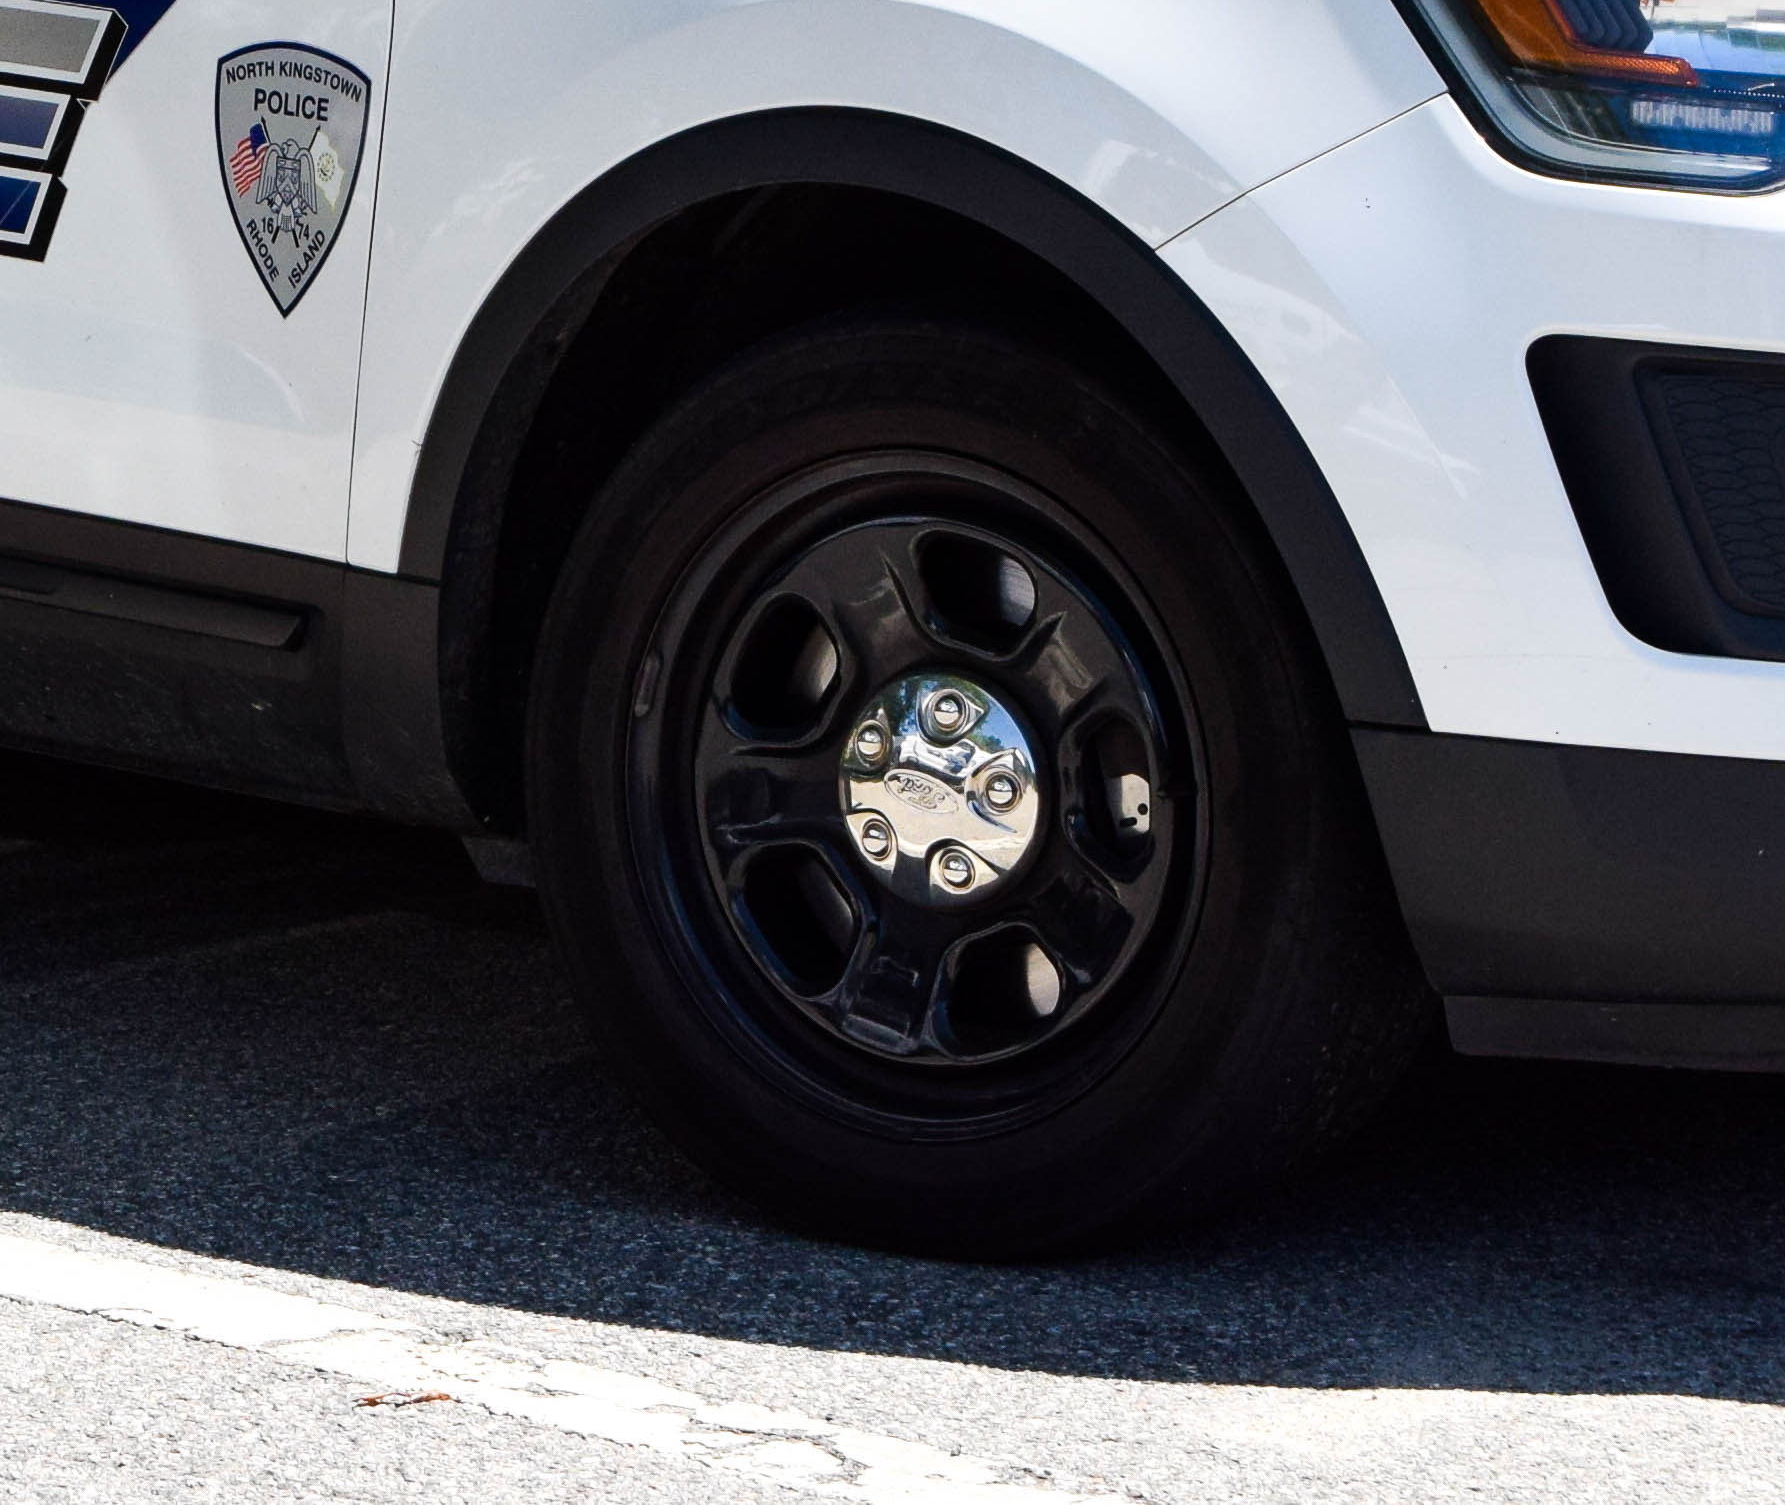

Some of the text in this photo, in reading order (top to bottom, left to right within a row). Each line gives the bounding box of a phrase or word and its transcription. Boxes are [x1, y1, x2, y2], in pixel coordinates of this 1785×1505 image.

[226, 61, 362, 102] NORTH KINGSTOWN
[253, 88, 330, 122] POLICE
[246, 219, 326, 289] RHODE ISLAND
